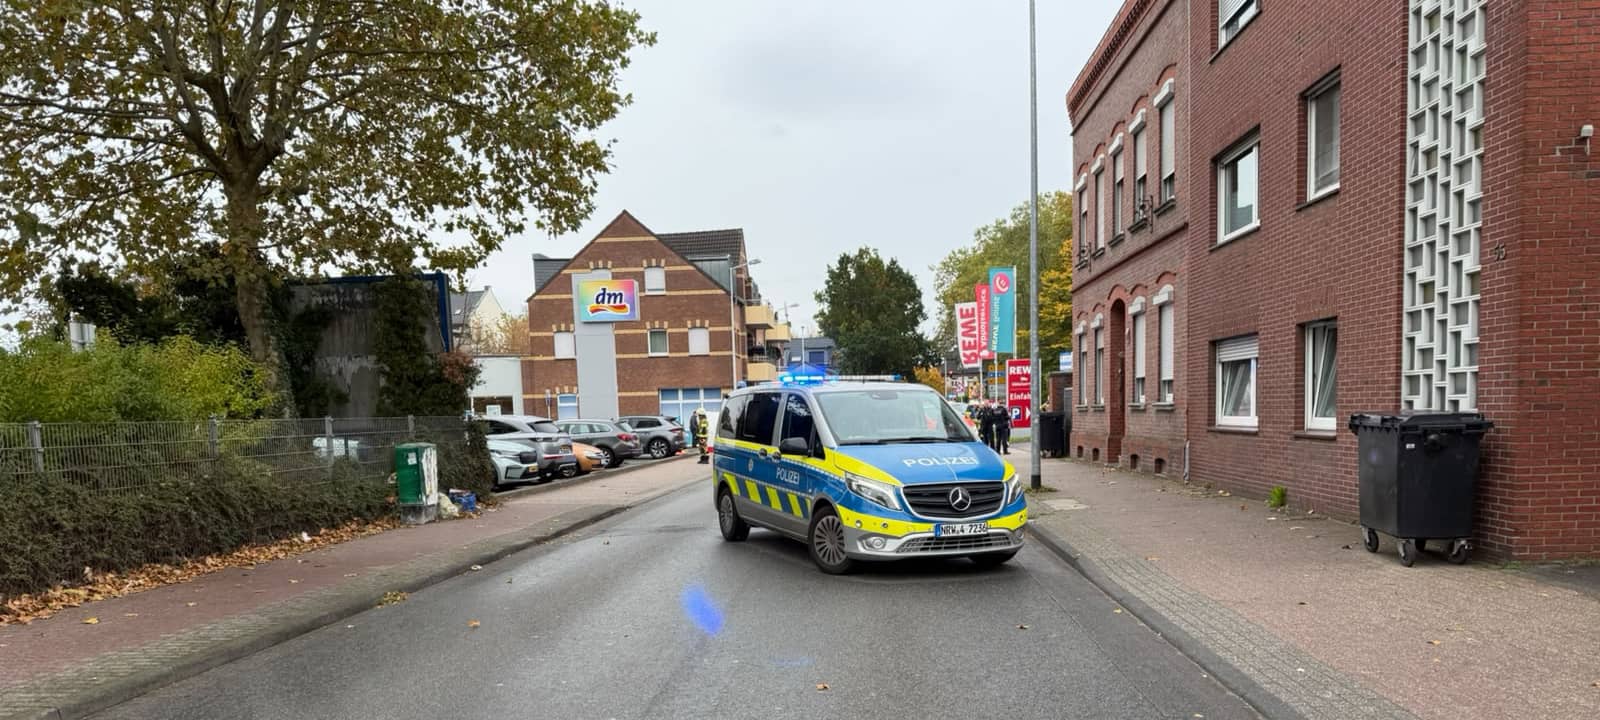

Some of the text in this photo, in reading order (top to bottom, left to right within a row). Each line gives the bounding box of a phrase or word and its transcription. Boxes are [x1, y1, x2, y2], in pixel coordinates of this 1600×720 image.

[595, 287, 623, 305] dm
[1009, 366, 1032, 375] REW
[902, 456, 979, 468] POLIZEI
[775, 466, 800, 485] POLIZEI
[941, 525, 956, 535] NRW
